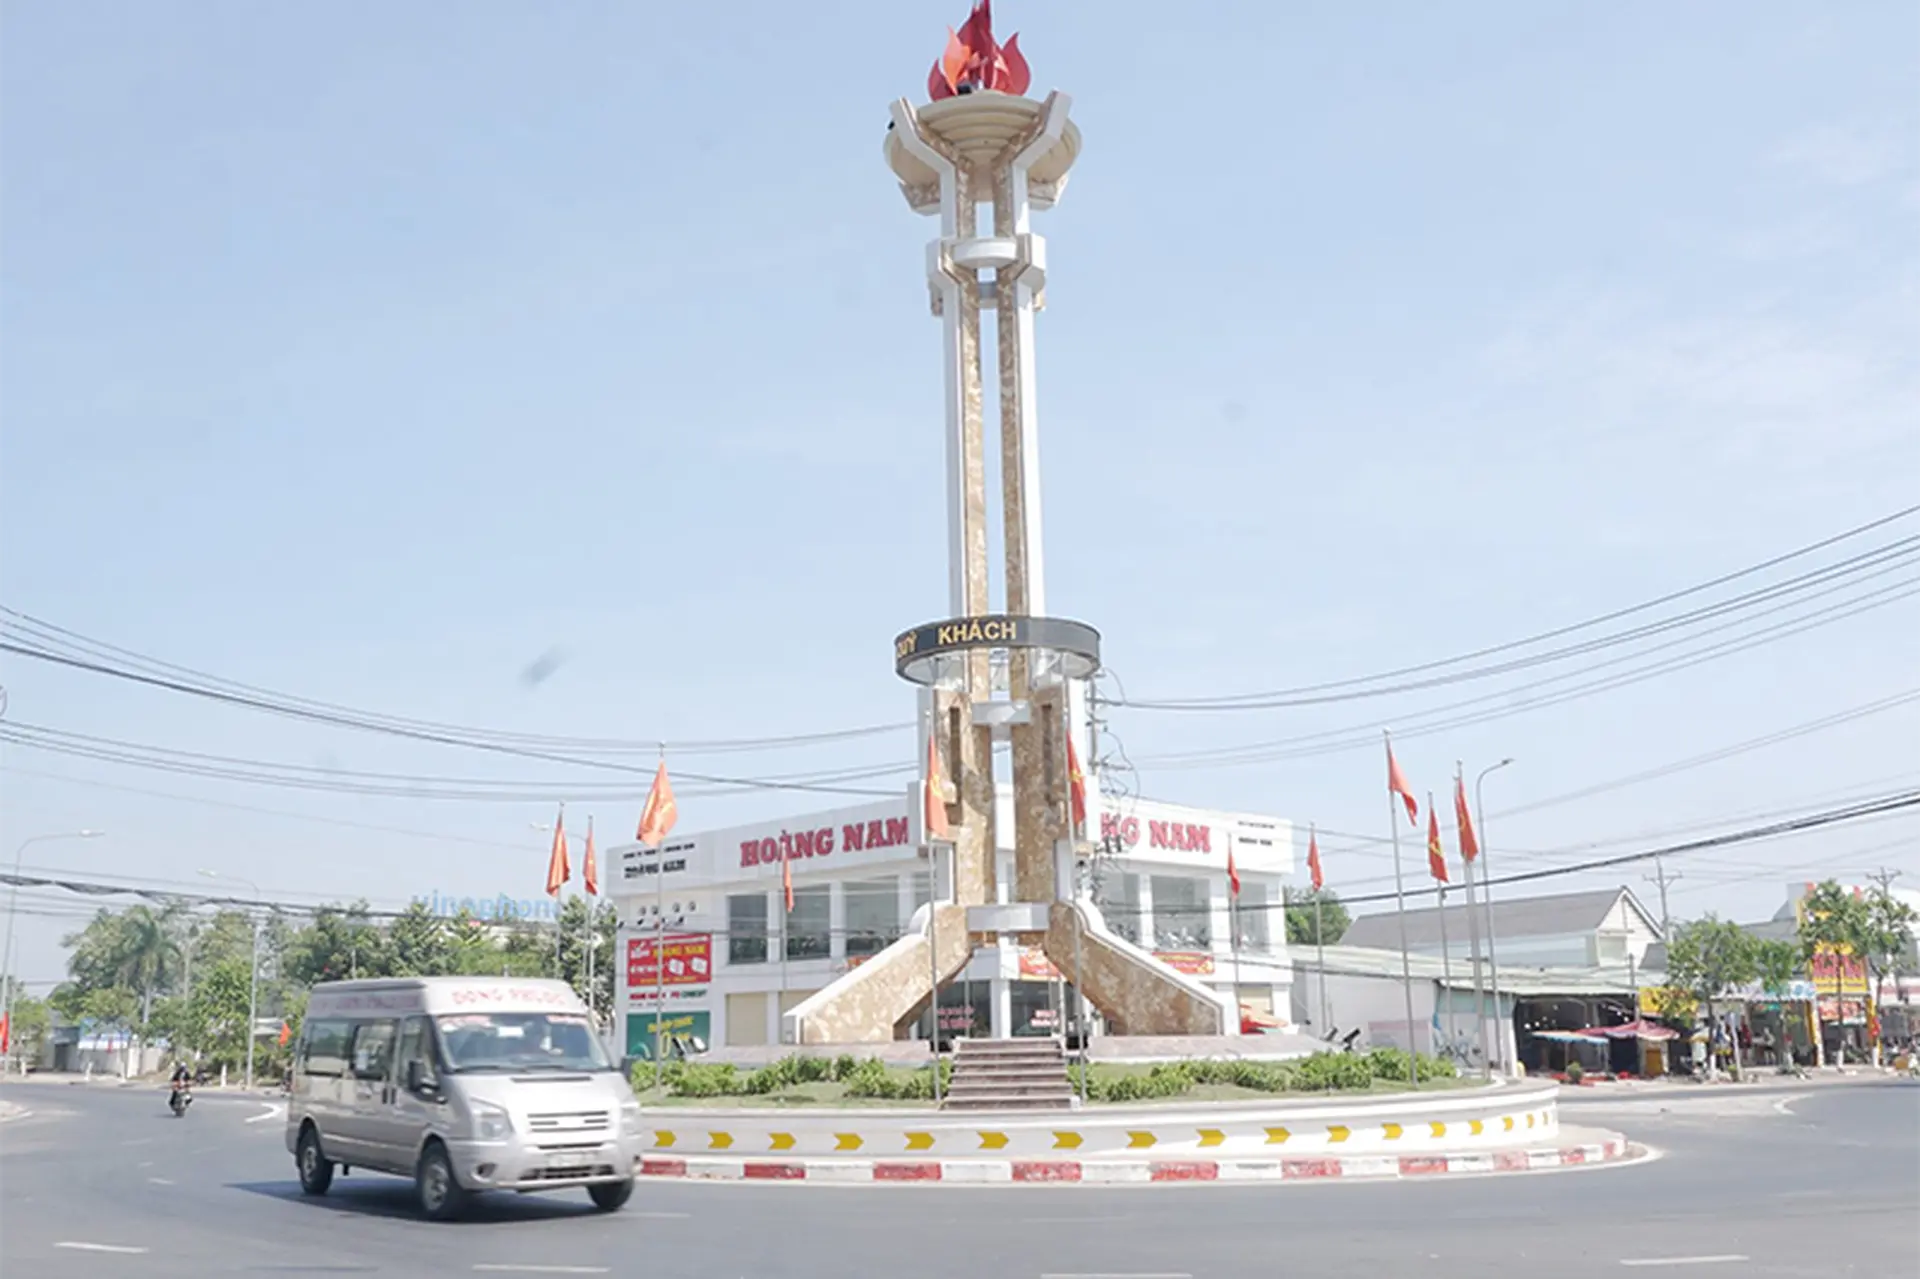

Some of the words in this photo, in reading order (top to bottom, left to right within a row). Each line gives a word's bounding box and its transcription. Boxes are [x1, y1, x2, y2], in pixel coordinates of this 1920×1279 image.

[938, 619, 1017, 646] KHÁCH
[740, 828, 834, 867] HOÀNG
[842, 816, 909, 852] NAM
[1148, 819, 1212, 853] NAM
